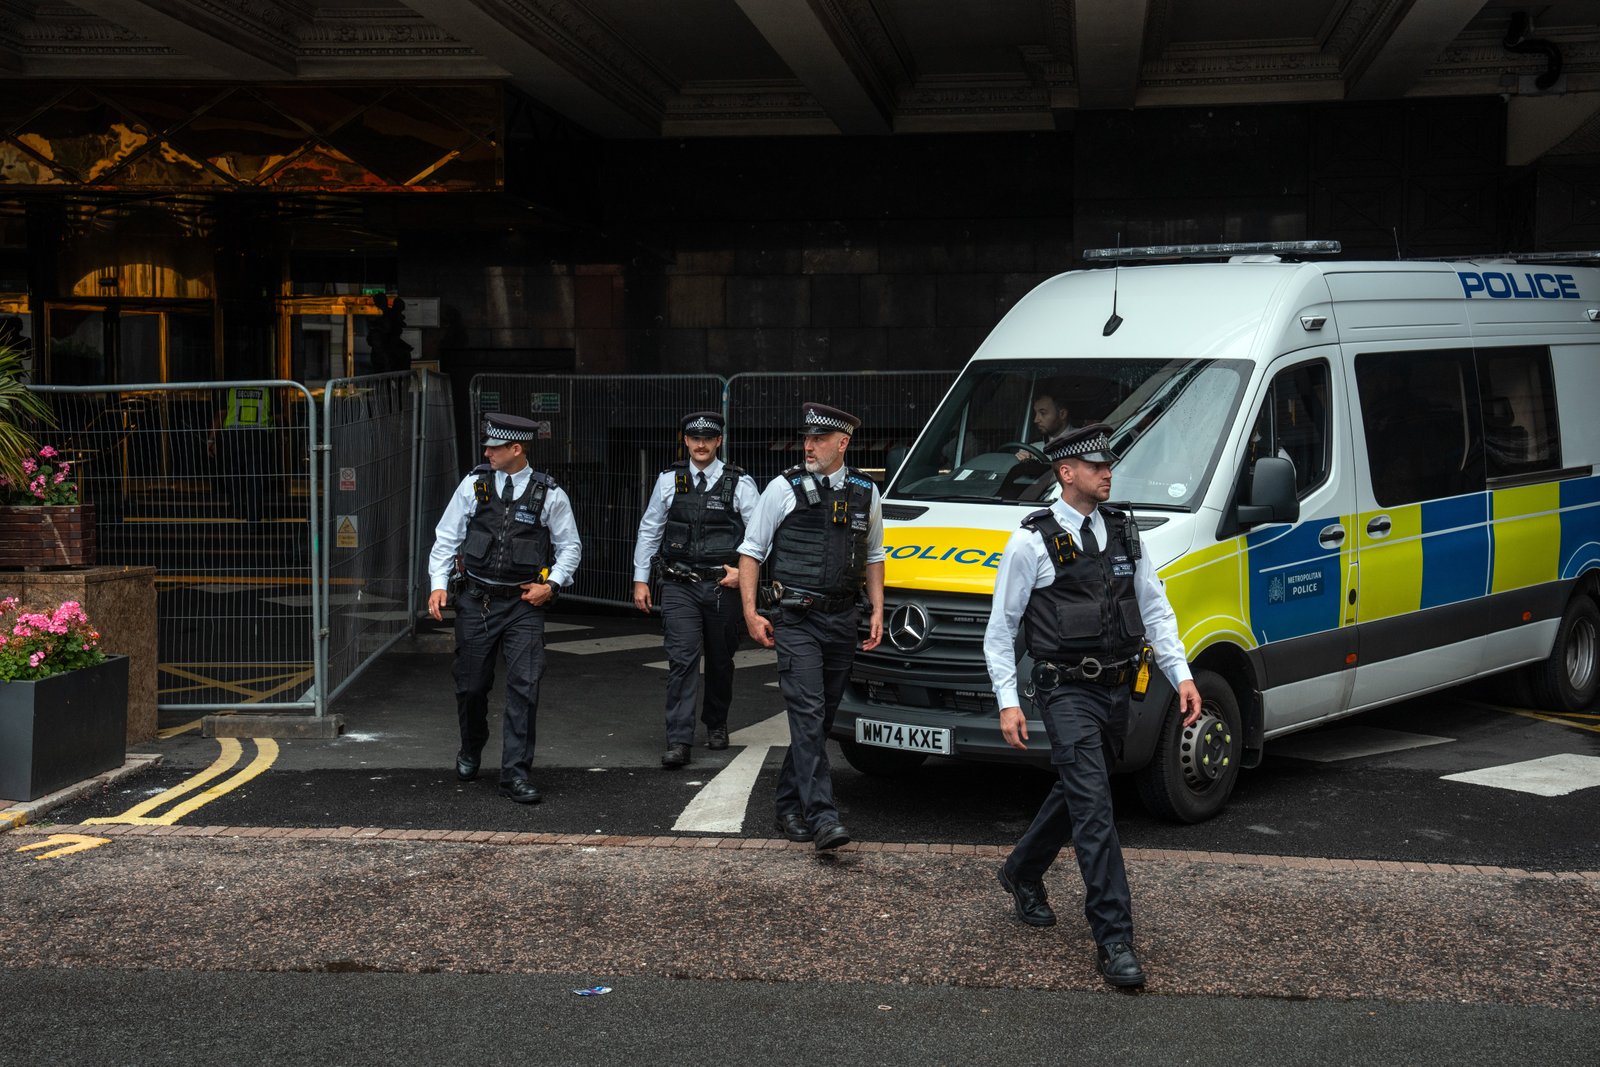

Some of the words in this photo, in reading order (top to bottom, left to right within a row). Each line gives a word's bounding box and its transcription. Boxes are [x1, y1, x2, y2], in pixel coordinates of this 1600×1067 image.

[1457, 271, 1580, 298] POLICE
[237, 390, 261, 398] SECURITY
[1287, 571, 1322, 584] METROPOLITAN
[1292, 583, 1318, 595] POLICE
[863, 722, 904, 745] WM74
[909, 728, 942, 750] KXE
